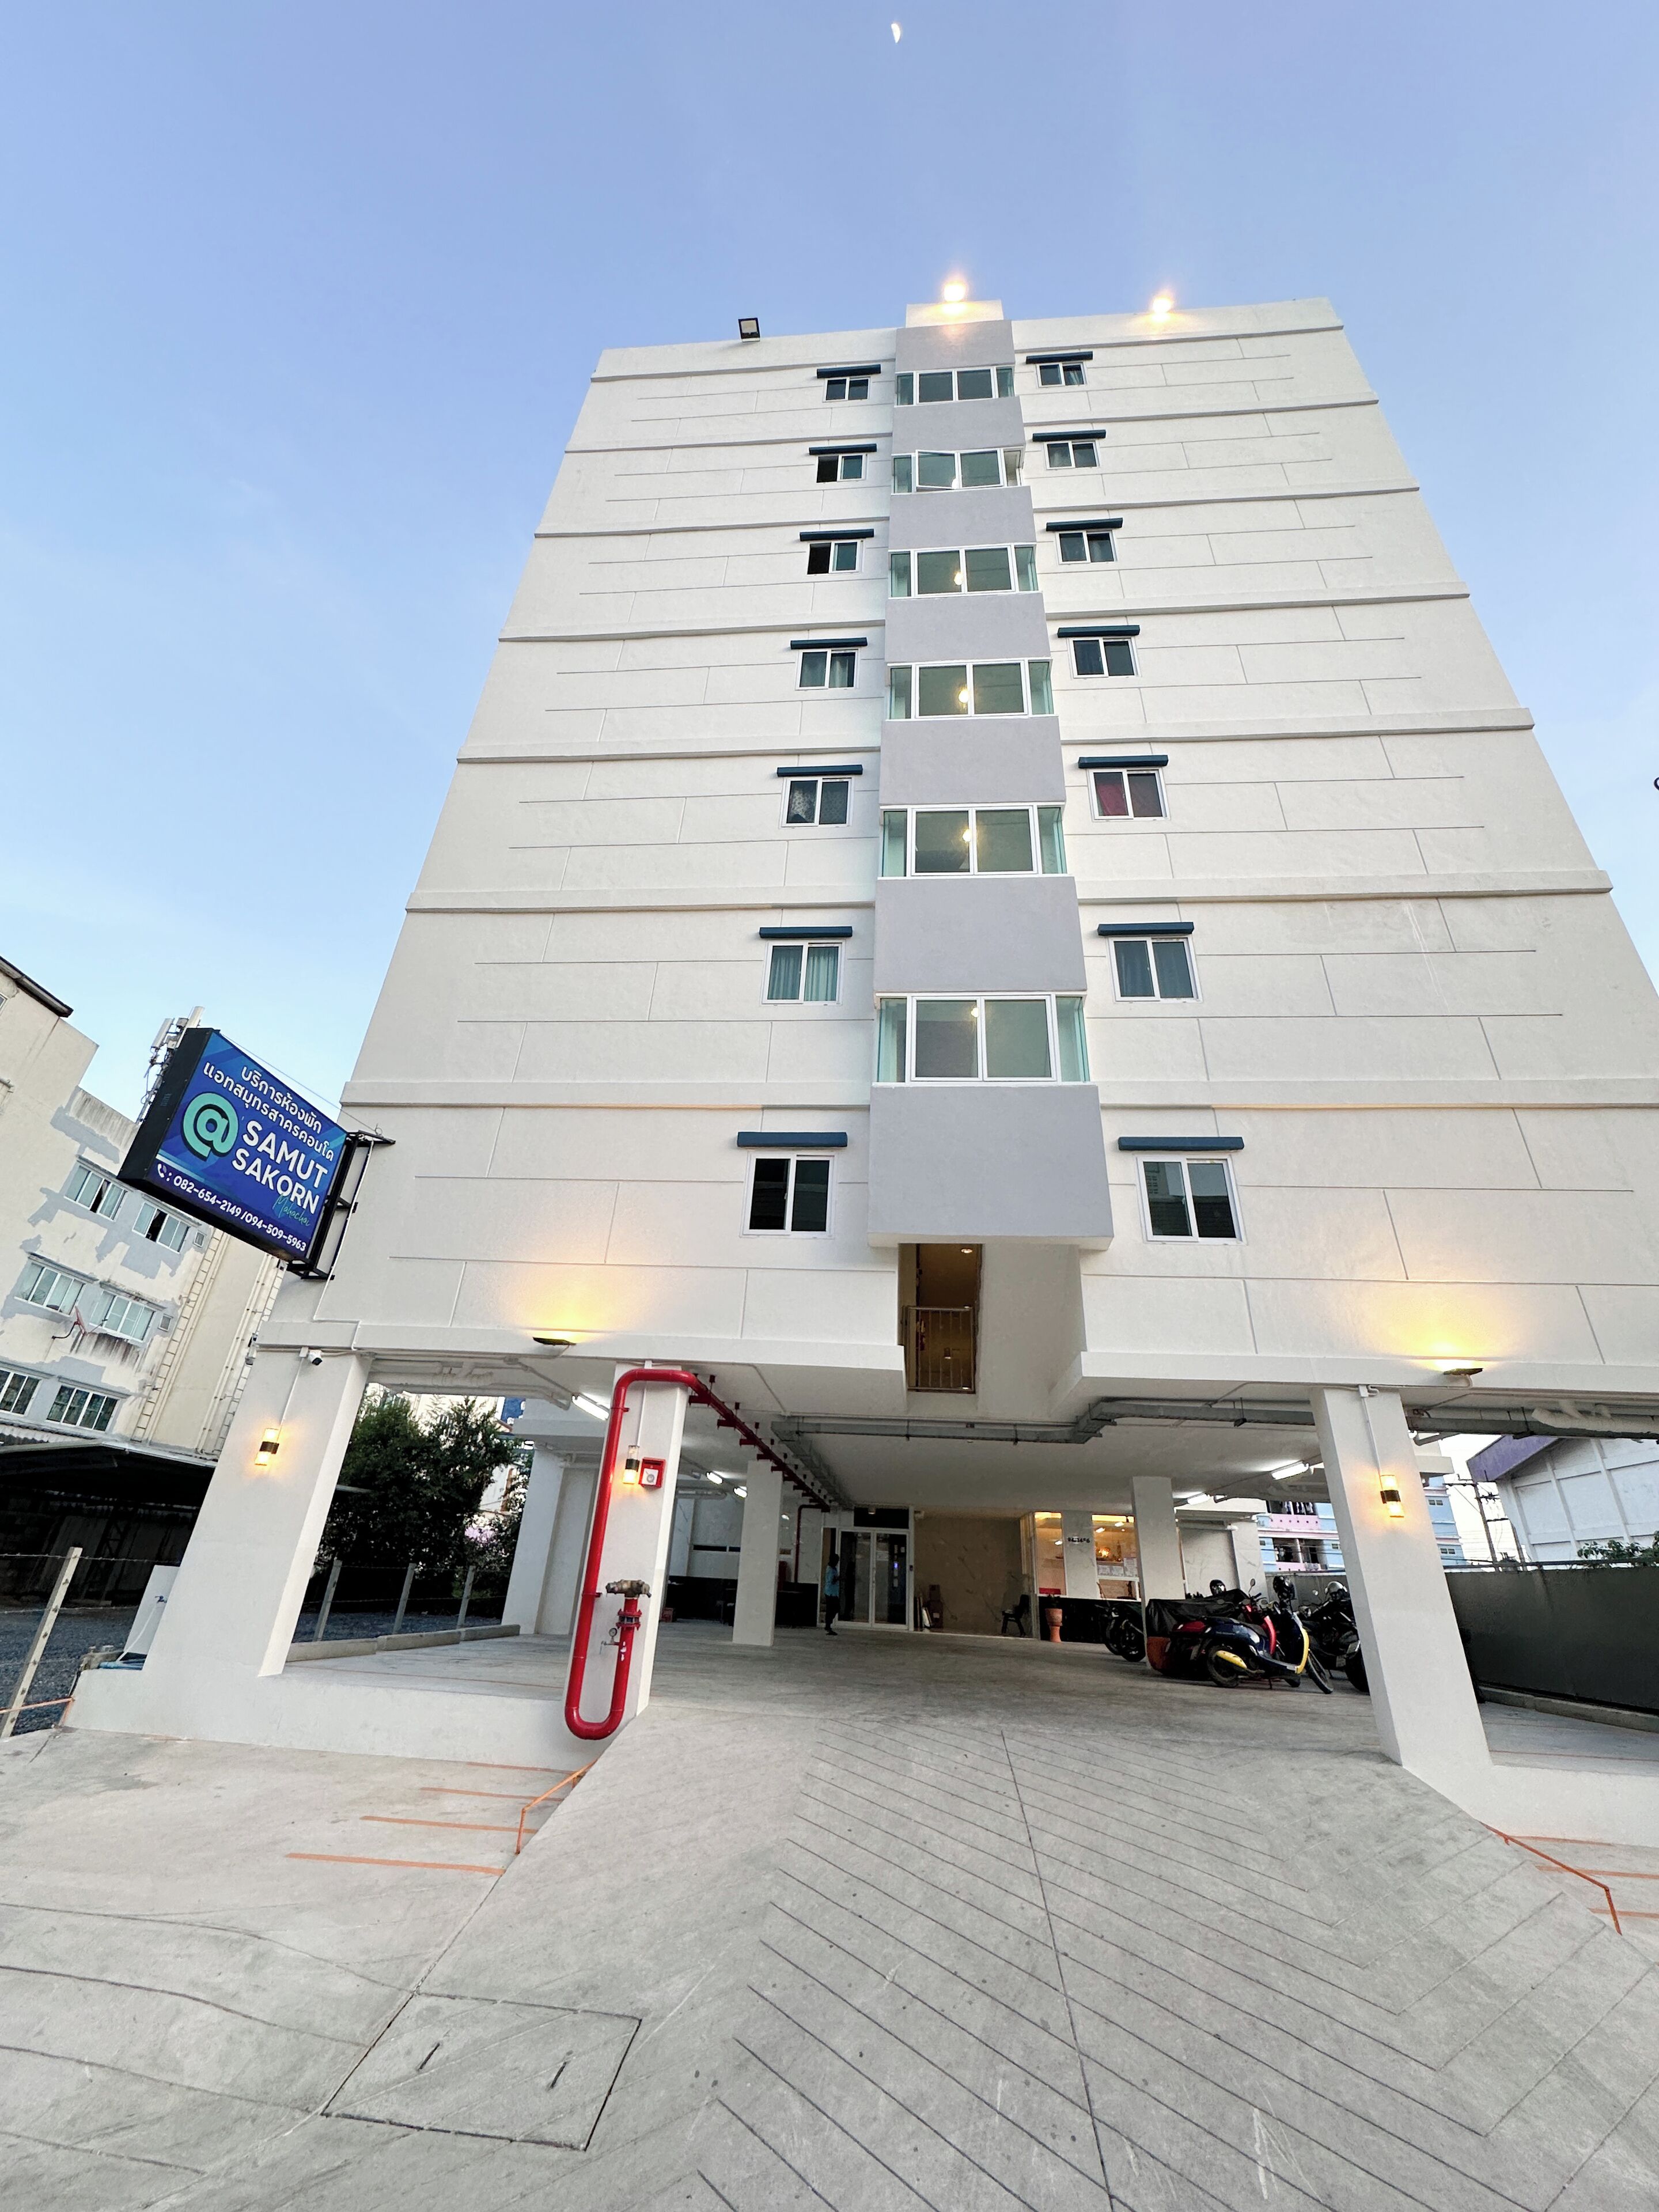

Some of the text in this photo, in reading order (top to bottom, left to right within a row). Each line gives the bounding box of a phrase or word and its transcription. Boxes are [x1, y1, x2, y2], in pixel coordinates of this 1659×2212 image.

[203, 1062, 334, 1161] แอทสมุทรสาครคอนโด
[241, 1067, 322, 1134] บริการห้องพัก
[232, 1148, 320, 1214] SAKORN
[243, 1120, 328, 1188] SAMUT
[173, 1176, 242, 1217] 082-654-2149
